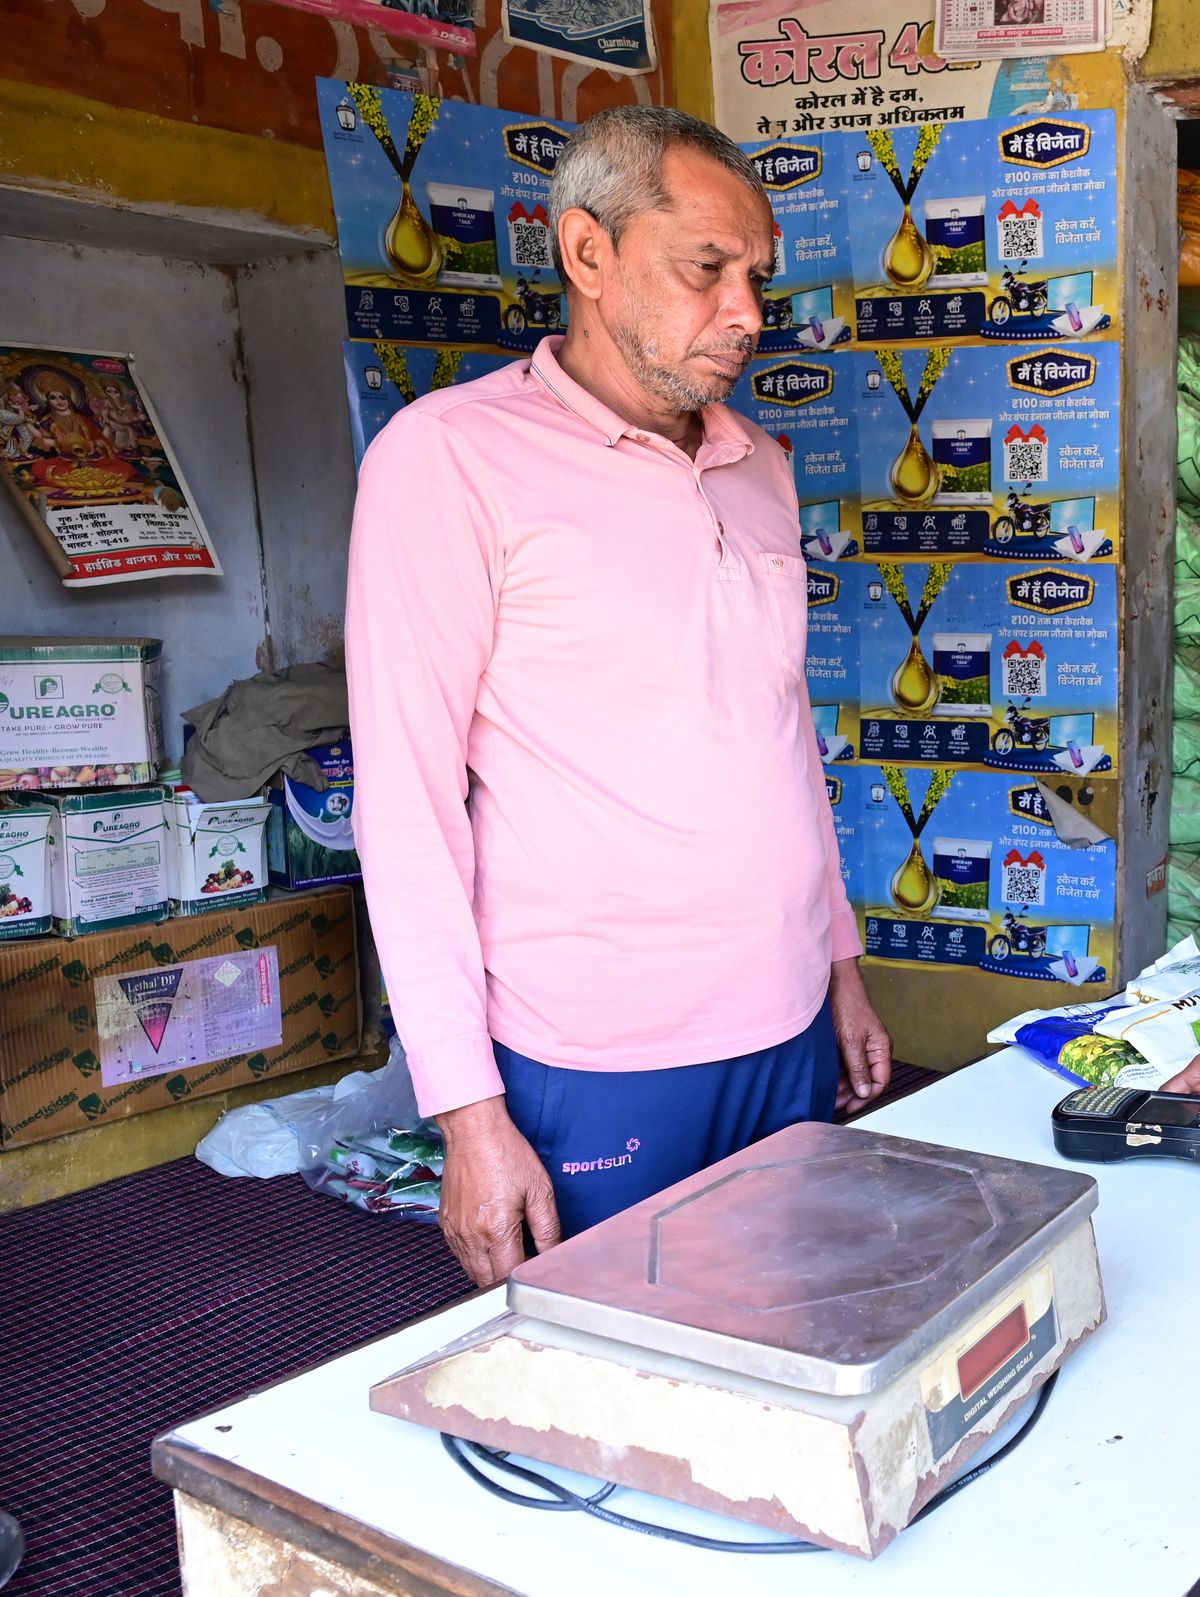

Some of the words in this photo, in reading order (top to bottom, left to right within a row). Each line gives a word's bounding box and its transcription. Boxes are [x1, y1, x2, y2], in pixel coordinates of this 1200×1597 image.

[440, 31, 469, 44] DSCL
[598, 37, 639, 49] Charminar
[738, 18, 885, 87] कोरल
[795, 91, 846, 111] कोरल
[852, 87, 866, 105] में
[870, 86, 884, 106] है
[889, 88, 924, 104] दम,
[792, 113, 824, 132] और
[830, 115, 872, 130] उपज
[878, 105, 965, 125] अधिकतम
[1009, 132, 1022, 154] मैं
[1025, 132, 1035, 158] हूँ
[1037, 132, 1080, 152] विजेता
[775, 156, 815, 175] विजेता
[1055, 231, 1083, 246] विजेता
[786, 373, 825, 391] विजेता
[1017, 362, 1031, 381] मैं
[1032, 361, 1042, 386] हूँ
[1043, 361, 1086, 380] विजेता
[1059, 457, 1087, 470] विजेता
[79, 512, 106, 521] विकास
[129, 513, 156, 522] युवराज
[56, 523, 83, 534] हनुमान
[91, 520, 113, 529] लीडर
[162, 550, 180, 561] और
[1017, 580, 1031, 598] मैं
[1032, 580, 1042, 604] हूँ
[1042, 580, 1085, 599] विजेता
[1058, 674, 1085, 687] विजेता
[80, 745, 107, 754] Wealthy
[1018, 792, 1032, 809] मैं
[93, 820, 140, 834] PUREAGRO
[1056, 885, 1083, 898] विजेता
[177, 925, 233, 958] insecticides
[128, 977, 158, 993] Lethal
[161, 974, 175, 987] DP
[11, 1090, 79, 1135] insecticides
[562, 1153, 632, 1175] sportsun
[964, 1396, 988, 1423] DIGITAL
[987, 1367, 1017, 1399] WEIGHING
[1015, 1351, 1035, 1372] SCALE
